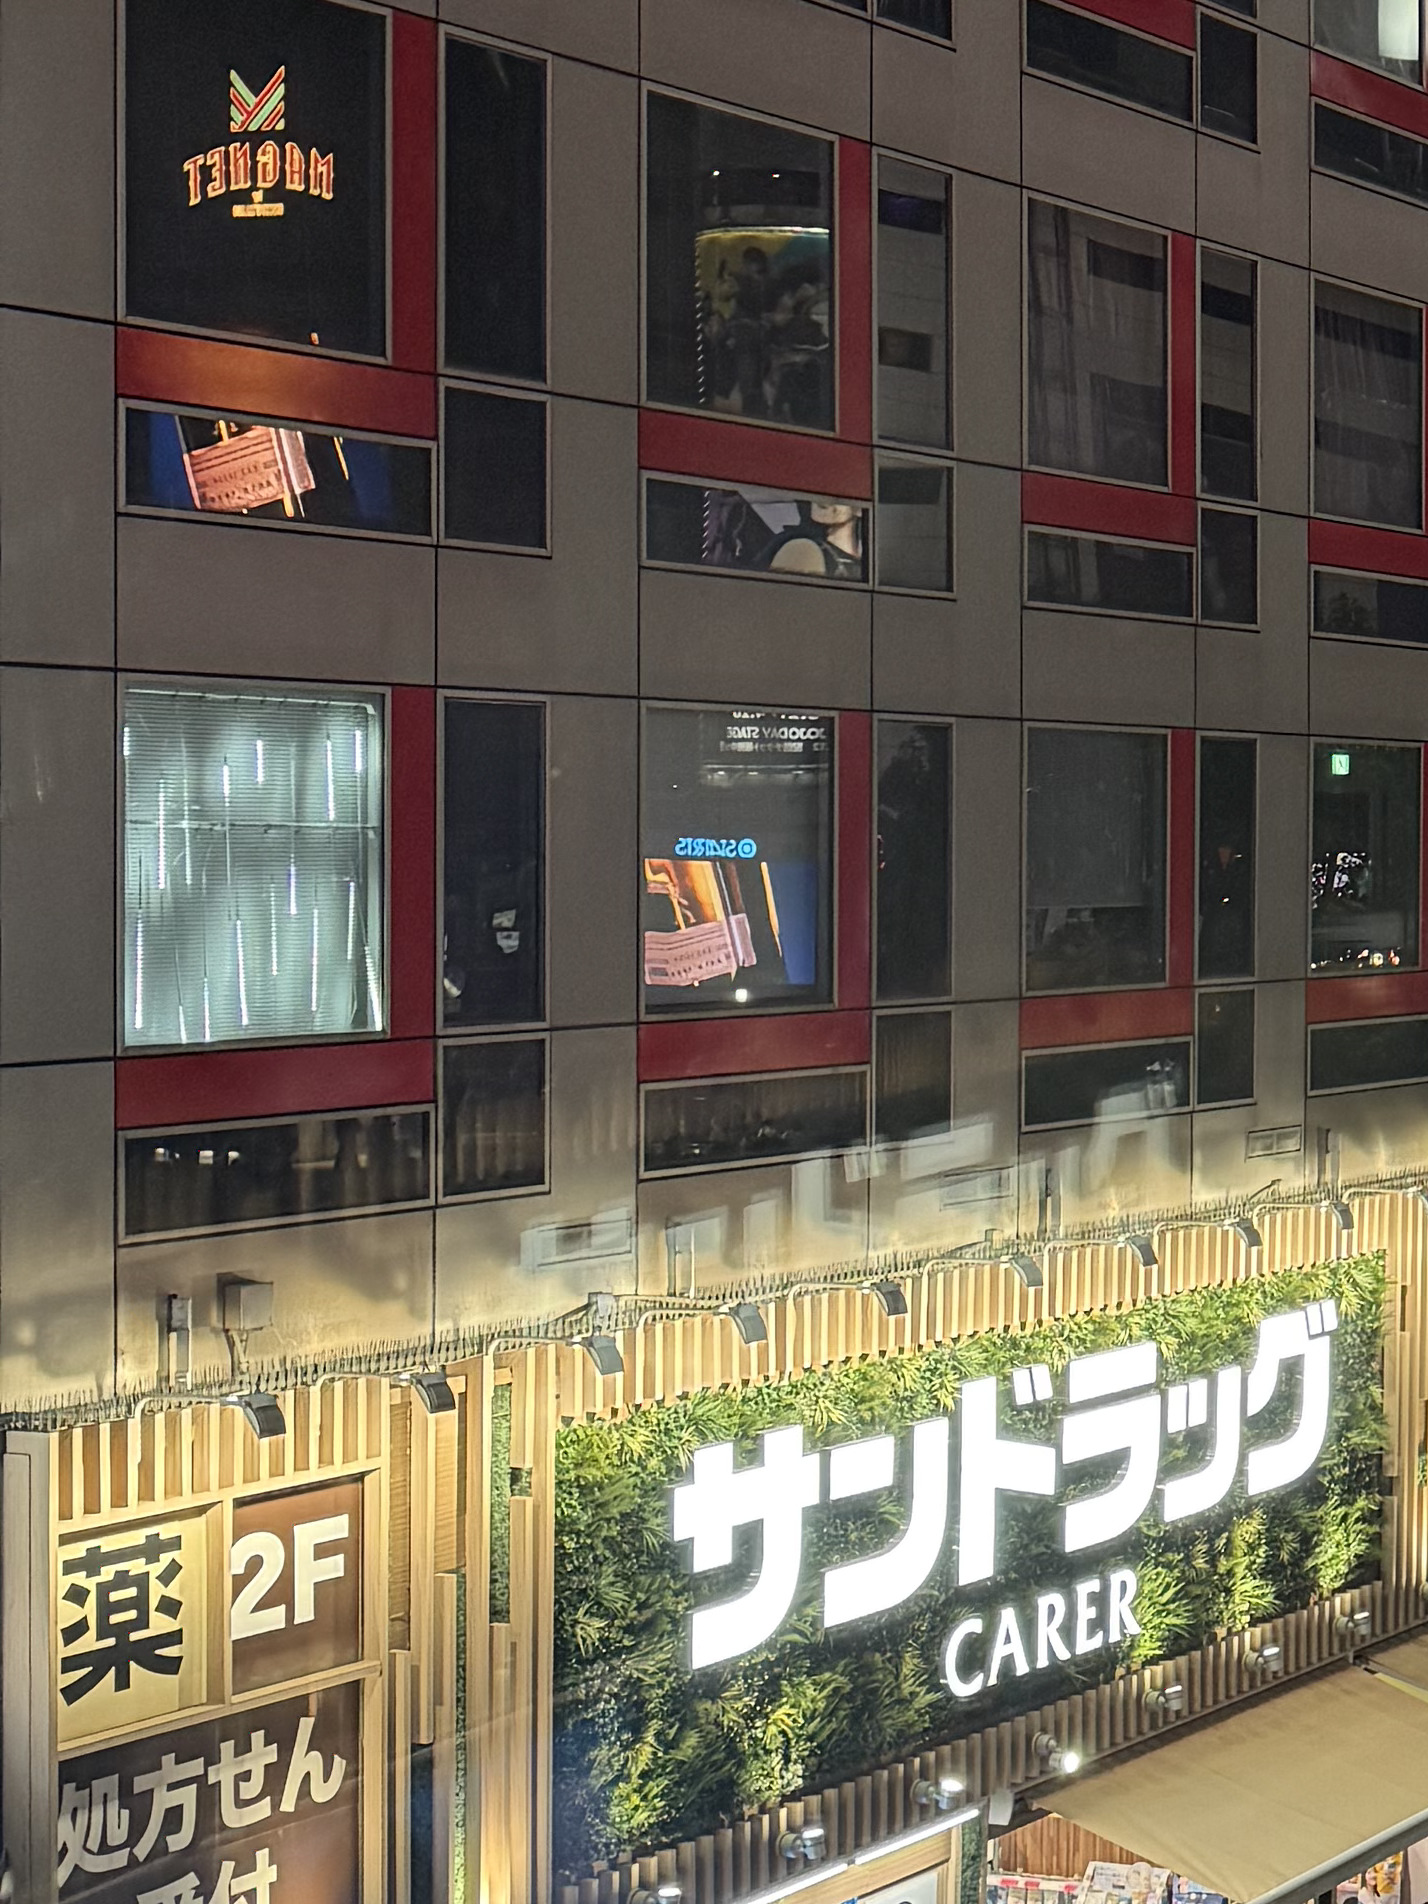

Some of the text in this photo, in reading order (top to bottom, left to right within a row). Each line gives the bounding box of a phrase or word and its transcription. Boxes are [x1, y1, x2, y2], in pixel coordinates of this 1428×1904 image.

[673, 1298, 1339, 1670] サンドラッグ
[60, 1533, 185, 1708] 薬
[231, 1513, 349, 1642] 2F
[943, 1568, 1143, 1697] CARER
[57, 1716, 346, 1889] 処方せん
